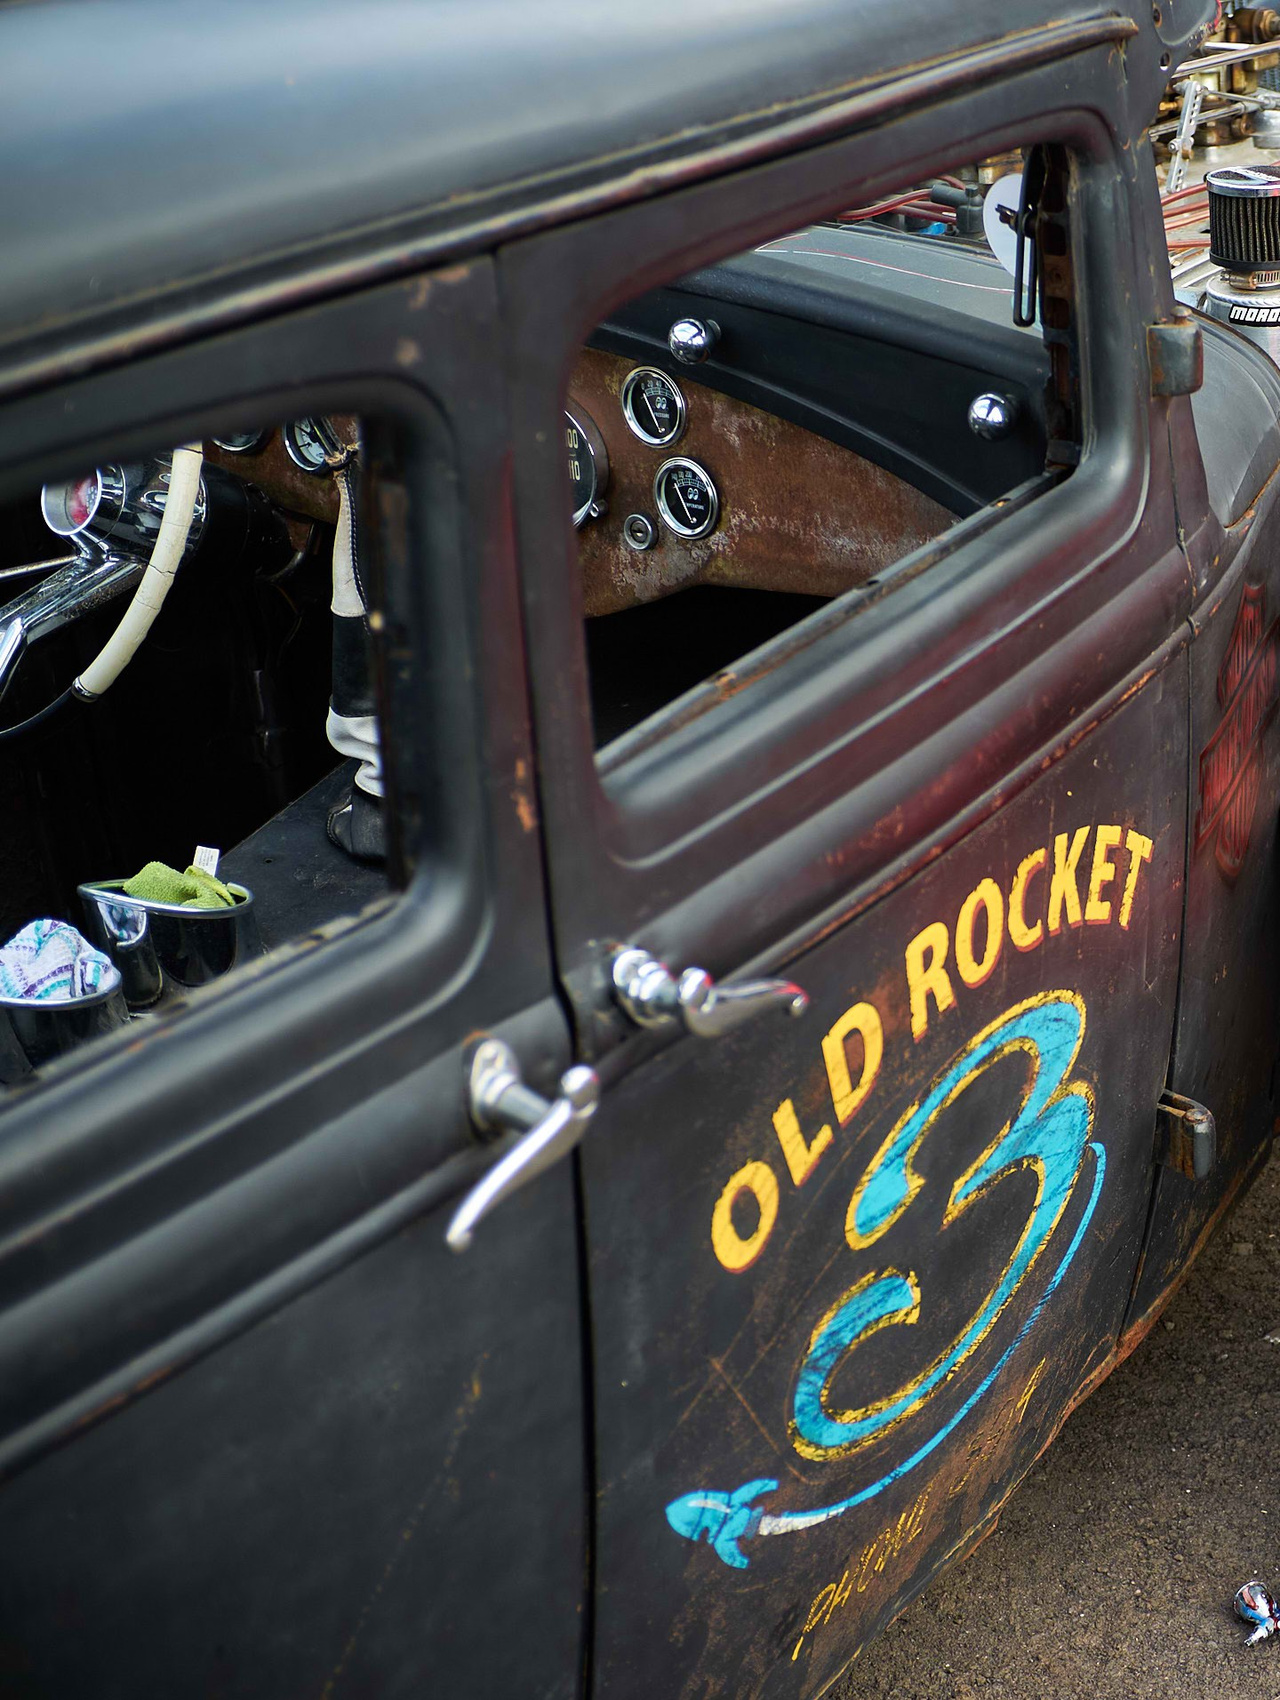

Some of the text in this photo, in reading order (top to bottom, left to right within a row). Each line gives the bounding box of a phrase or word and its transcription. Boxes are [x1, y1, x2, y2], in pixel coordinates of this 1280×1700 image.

[711, 824, 1154, 1274] OLD ROCKET
[788, 988, 1096, 1461] 3
